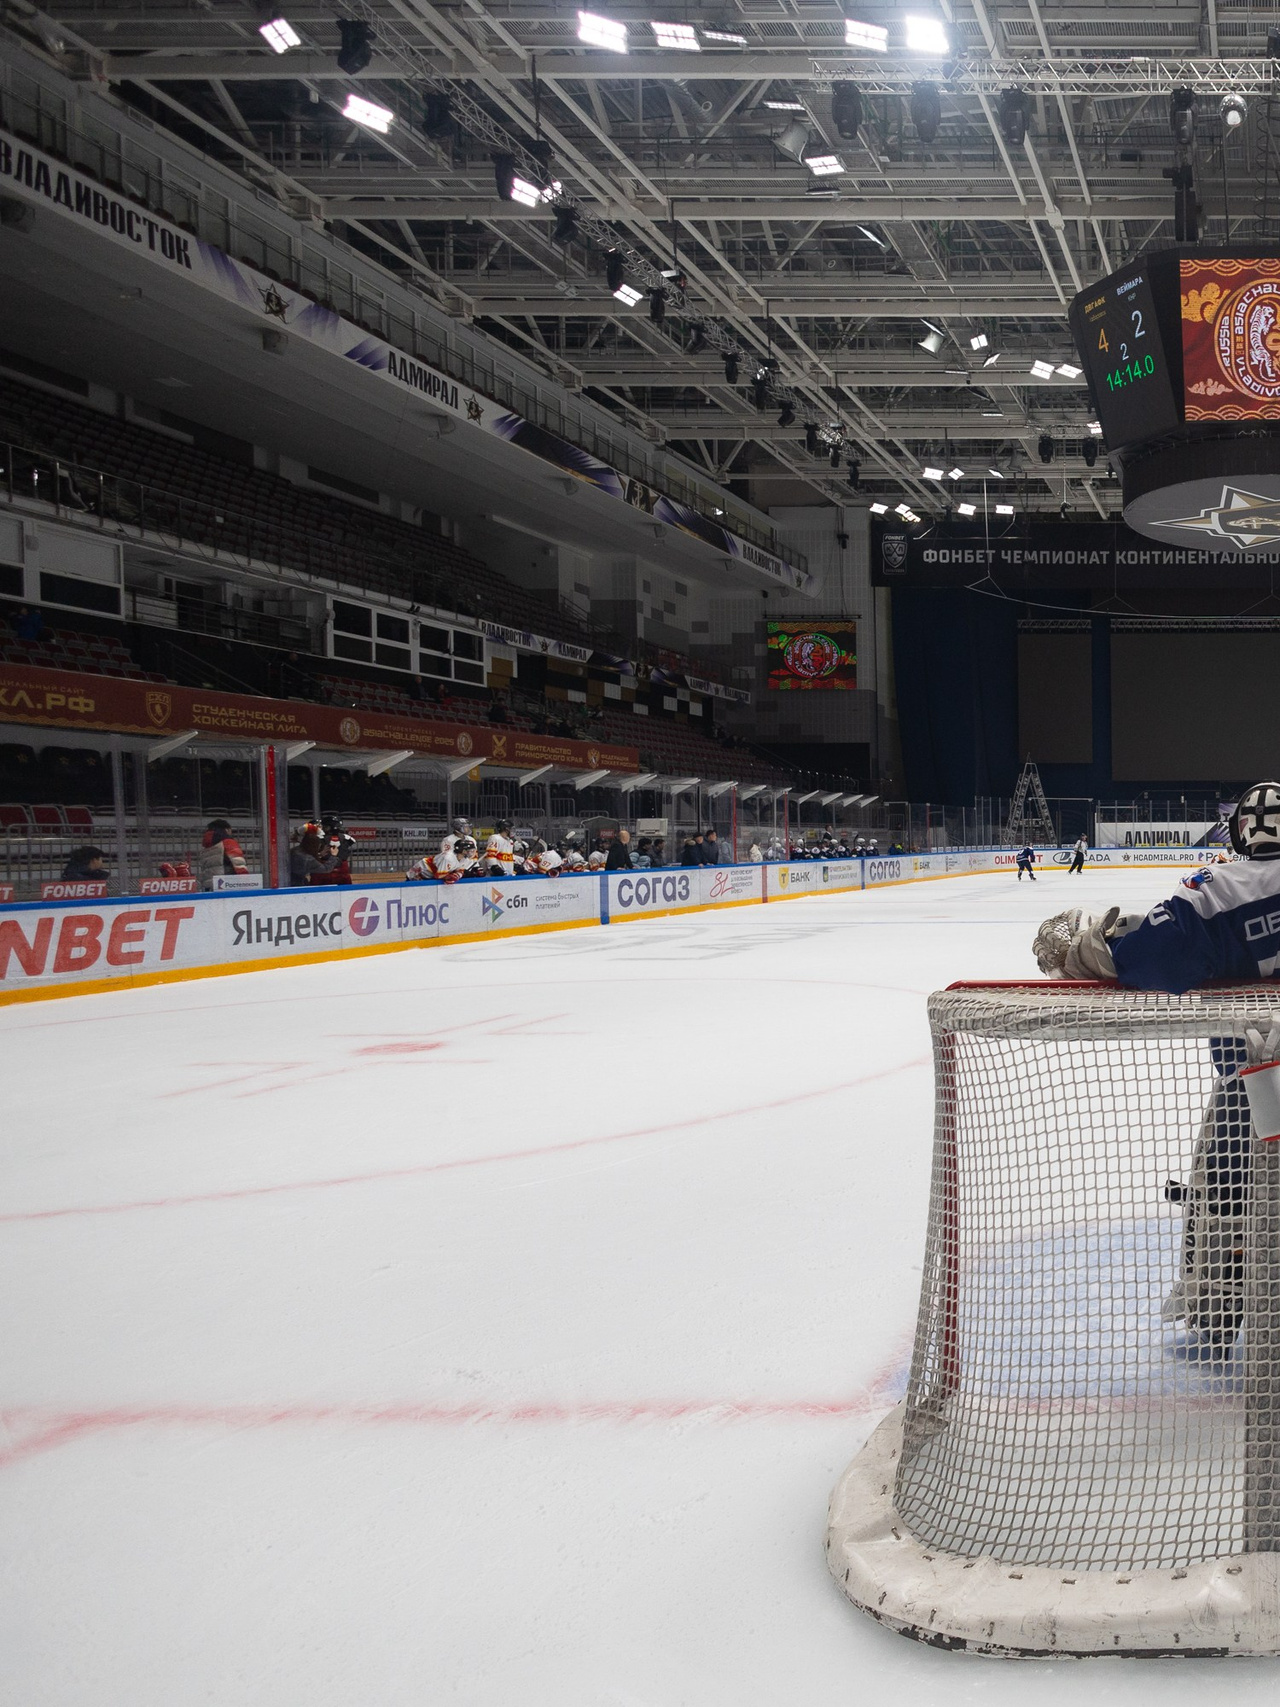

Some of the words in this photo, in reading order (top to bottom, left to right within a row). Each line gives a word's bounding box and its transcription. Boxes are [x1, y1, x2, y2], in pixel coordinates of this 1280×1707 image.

[1116, 276, 1143, 296] ВЕЙМАРА
[1131, 310, 1146, 339] 2
[1098, 328, 1109, 353] 4
[1120, 342, 1130, 361] 2
[388, 350, 459, 410] АДМИРАЛ
[1106, 354, 1155, 392] 14:14.0
[923, 549, 996, 564] ФОНБЕТ
[1001, 550, 1110, 565] ЧЕМПИОНАТ
[60, 686, 85, 694] САЙТ
[192, 704, 296, 723] СТУДЕНЧЕСКАЯ
[192, 714, 274, 731] ХОККЕЙНАЯ
[276, 724, 308, 734] ЛИГА
[515, 742, 572, 755] ПРАВИТЕЛЬСТВО
[515, 750, 564, 762] ПРИМОРСКОГО
[566, 754, 584, 763] КРАЯ
[1125, 831, 1190, 846] АДМИРАЛ
[995, 854, 1043, 865] OLIMT
[1133, 853, 1194, 861] HCADMIRAL.PRO
[791, 872, 810, 883] БАНК
[870, 860, 900, 881] согаз
[43, 883, 106, 898] FONBET
[141, 879, 195, 893] FONBET
[618, 875, 690, 907] согаз
[507, 896, 527, 908] сбп
[558, 892, 580, 901] быстрых
[232, 910, 342, 946] Яндекс
[386, 900, 449, 929] Плюс
